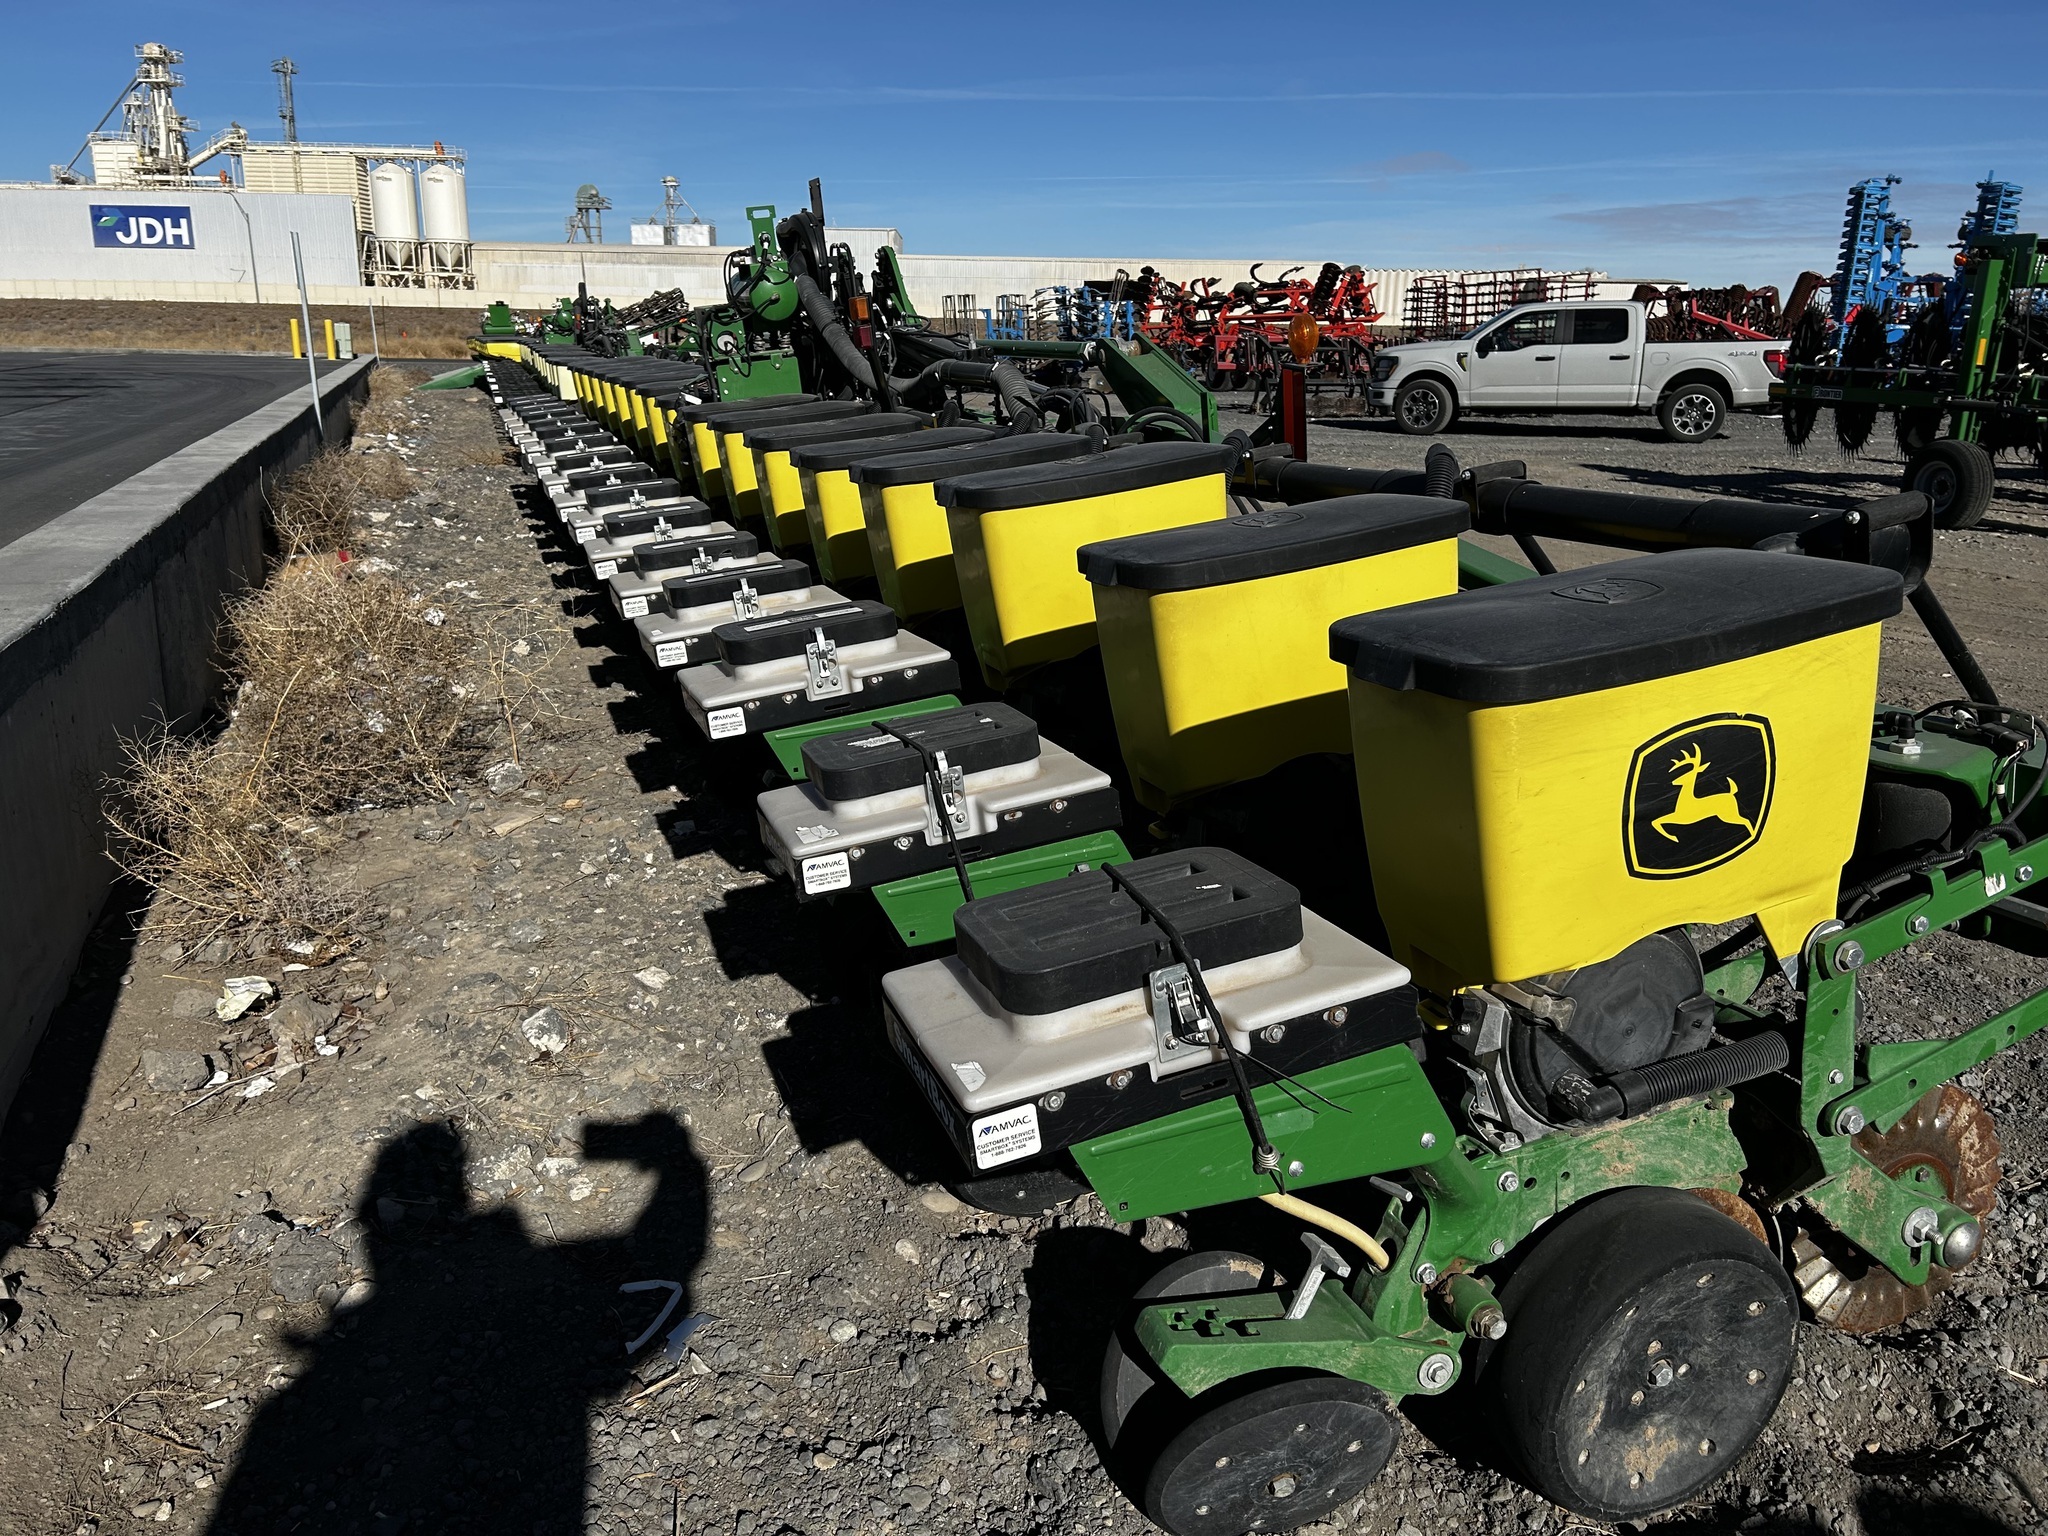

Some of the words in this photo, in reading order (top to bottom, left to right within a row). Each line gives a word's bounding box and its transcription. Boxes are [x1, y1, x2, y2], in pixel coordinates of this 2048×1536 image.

[115, 216, 190, 245] JDH
[815, 859, 845, 870] AMVAC
[991, 1115, 1032, 1134] AMVAC
[976, 1136, 1010, 1150] CUSTOMER
[1010, 1128, 1036, 1140] SERVICE
[1012, 1135, 1036, 1145] SYSTEMS
